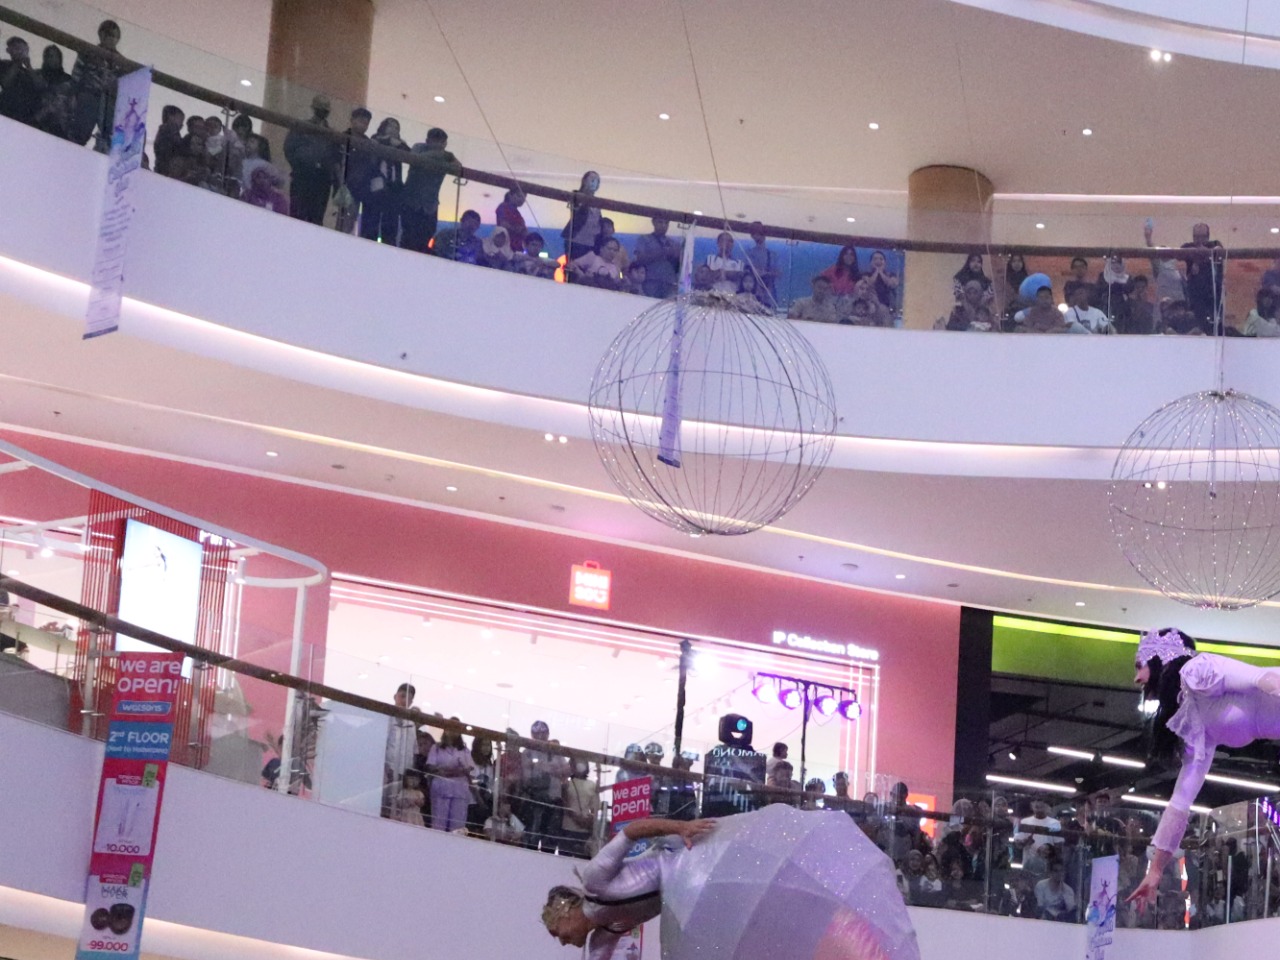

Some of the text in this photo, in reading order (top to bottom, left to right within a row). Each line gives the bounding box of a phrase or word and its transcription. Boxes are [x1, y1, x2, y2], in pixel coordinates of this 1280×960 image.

[120, 660, 182, 675] we are
[127, 732, 170, 744] FLOOR
[613, 783, 651, 801] we are
